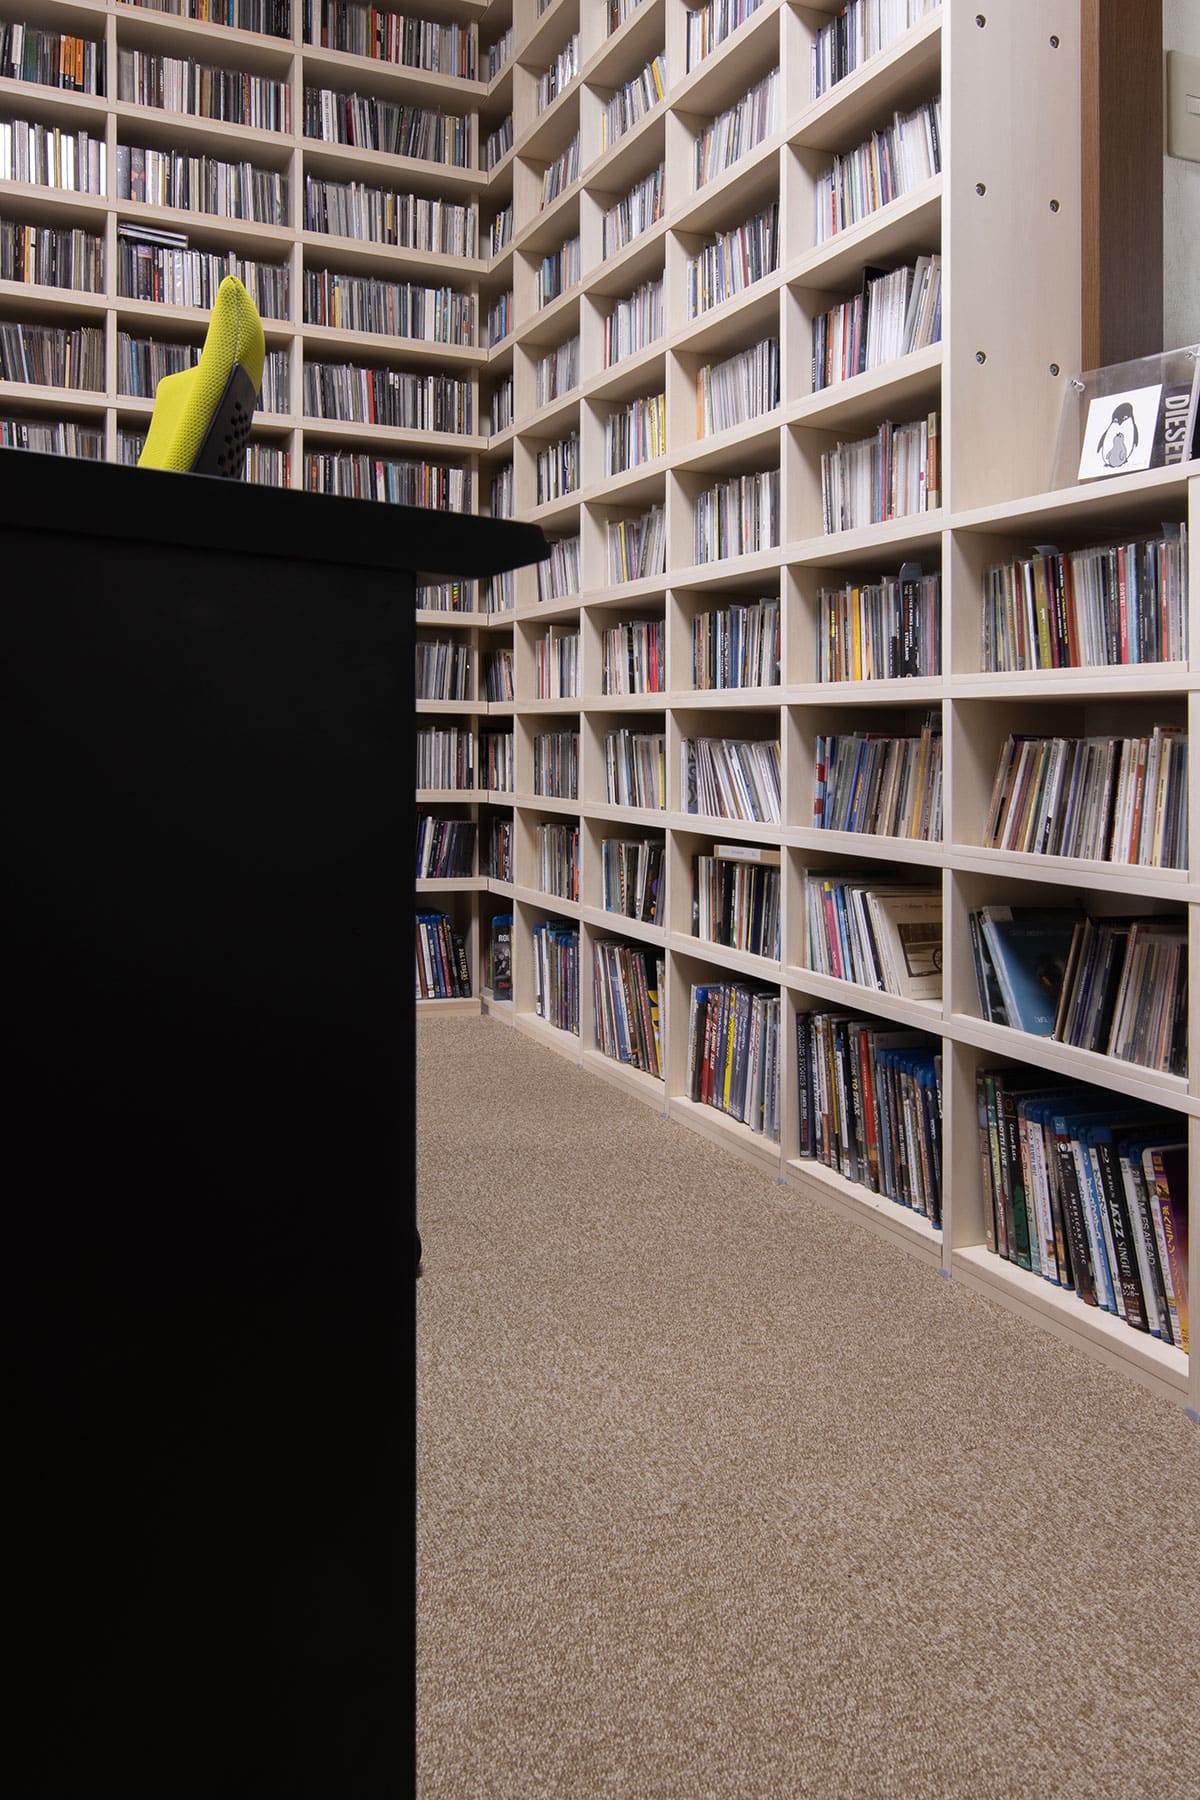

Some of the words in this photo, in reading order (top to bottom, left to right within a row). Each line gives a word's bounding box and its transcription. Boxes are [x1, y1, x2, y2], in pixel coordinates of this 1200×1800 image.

[995, 1091, 1004, 1118] CHRIS
[998, 1120, 1006, 1145] BOTTI
[1000, 1146, 1008, 1167] LIVE
[1070, 1191, 1083, 1239] AMERICAN
[1078, 1241, 1087, 1265] EPIC
[1109, 1199, 1124, 1240] JAZZ
[1117, 1241, 1131, 1278] SINGER
[1137, 1201, 1149, 1233] MILES
[1144, 1233, 1156, 1265] AHEAD
